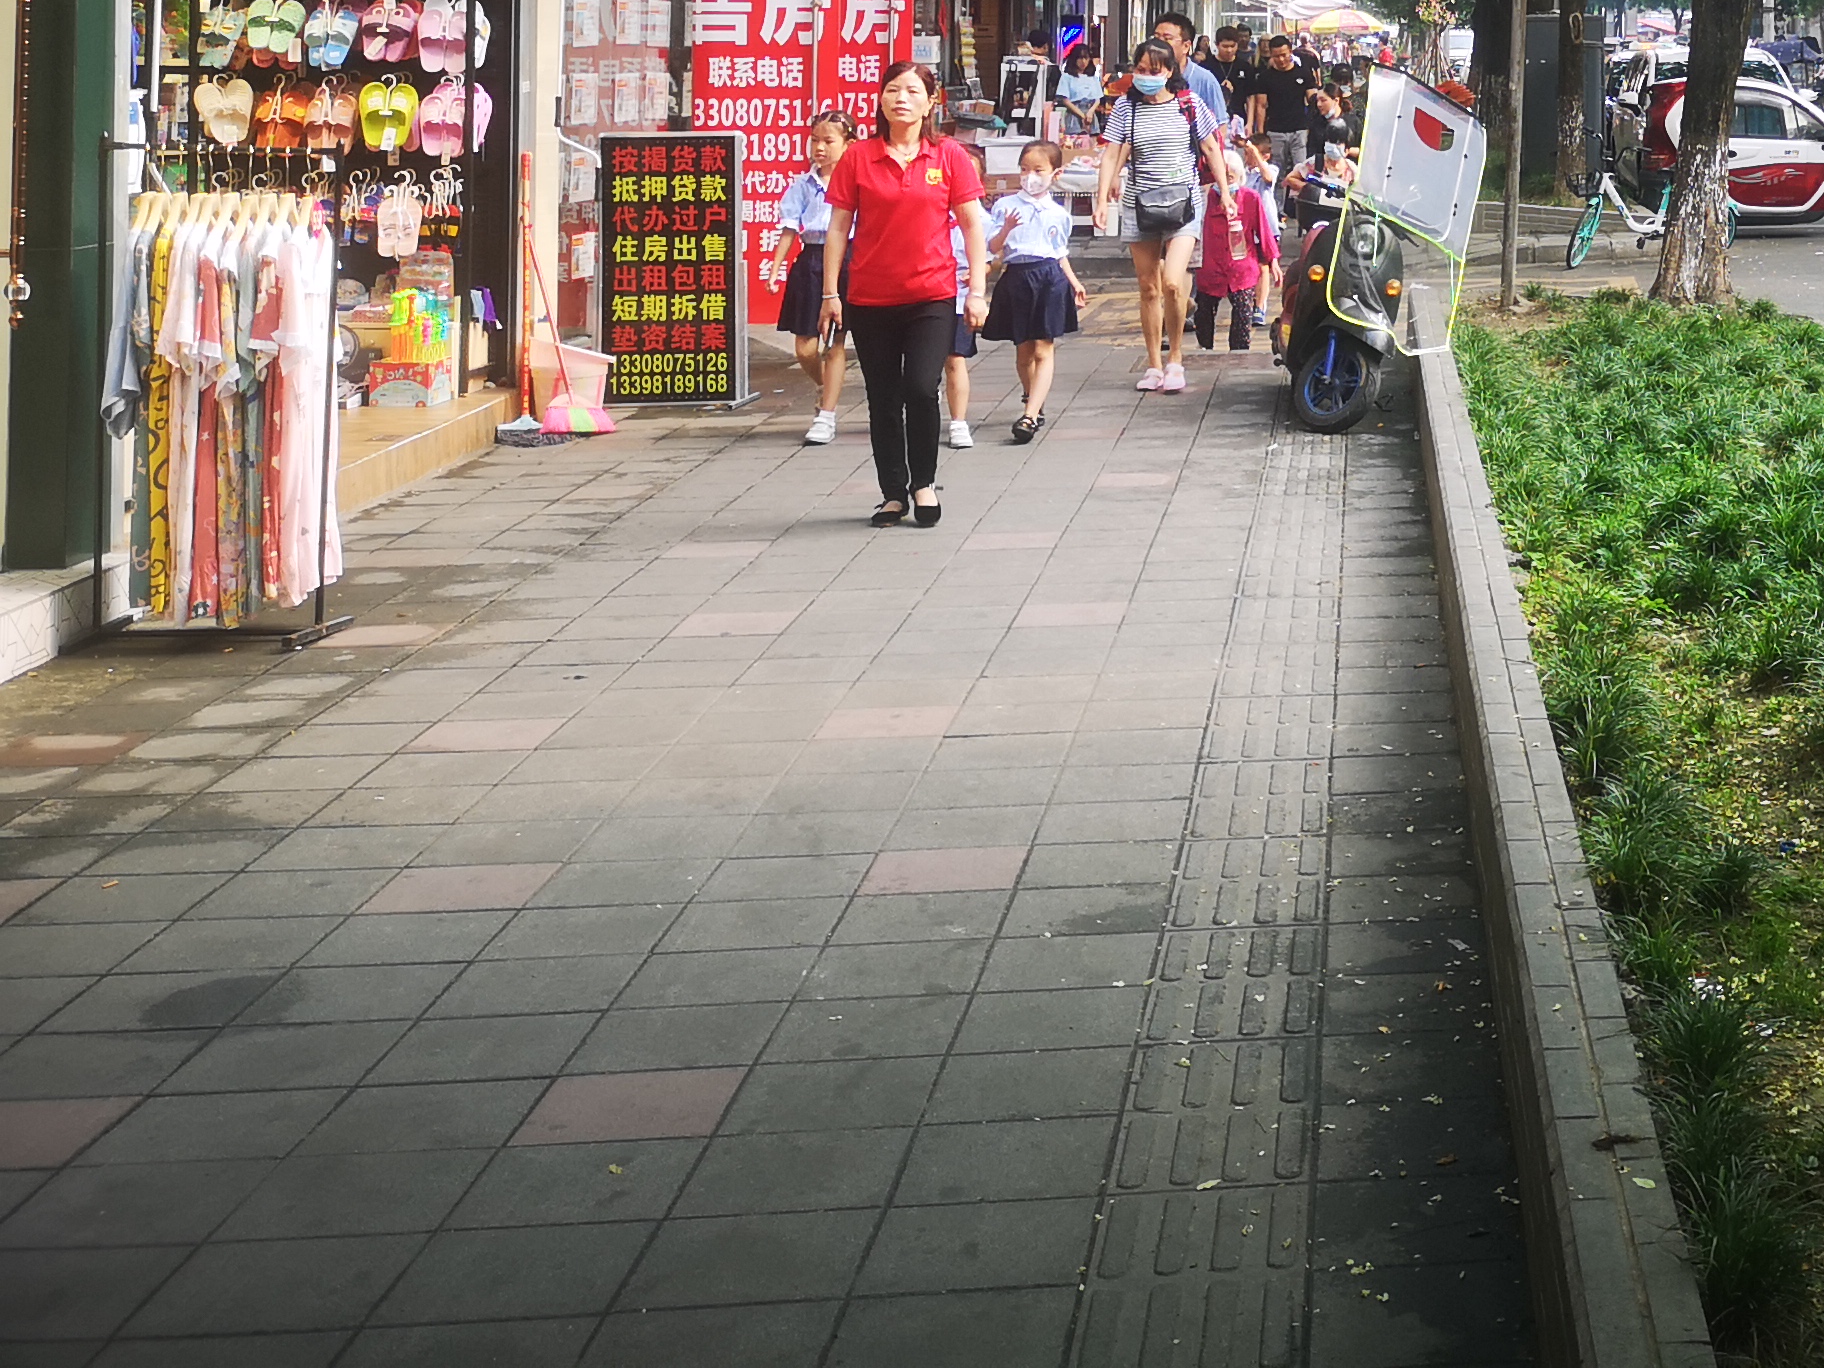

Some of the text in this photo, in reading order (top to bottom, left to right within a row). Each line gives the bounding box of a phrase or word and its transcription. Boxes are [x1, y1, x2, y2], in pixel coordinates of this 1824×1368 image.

[708, 56, 804, 88] 联系电话
[838, 54, 881, 83] 电话
[611, 175, 727, 202] 抵押贷款
[611, 204, 727, 232] 代办过户
[611, 234, 727, 262] 住房出售
[612, 263, 727, 292] 出租包租
[611, 294, 727, 322] 短期拆借
[611, 323, 727, 352] 垫资结案
[612, 353, 728, 374] 13308075126
[610, 373, 728, 395] 13398189168
